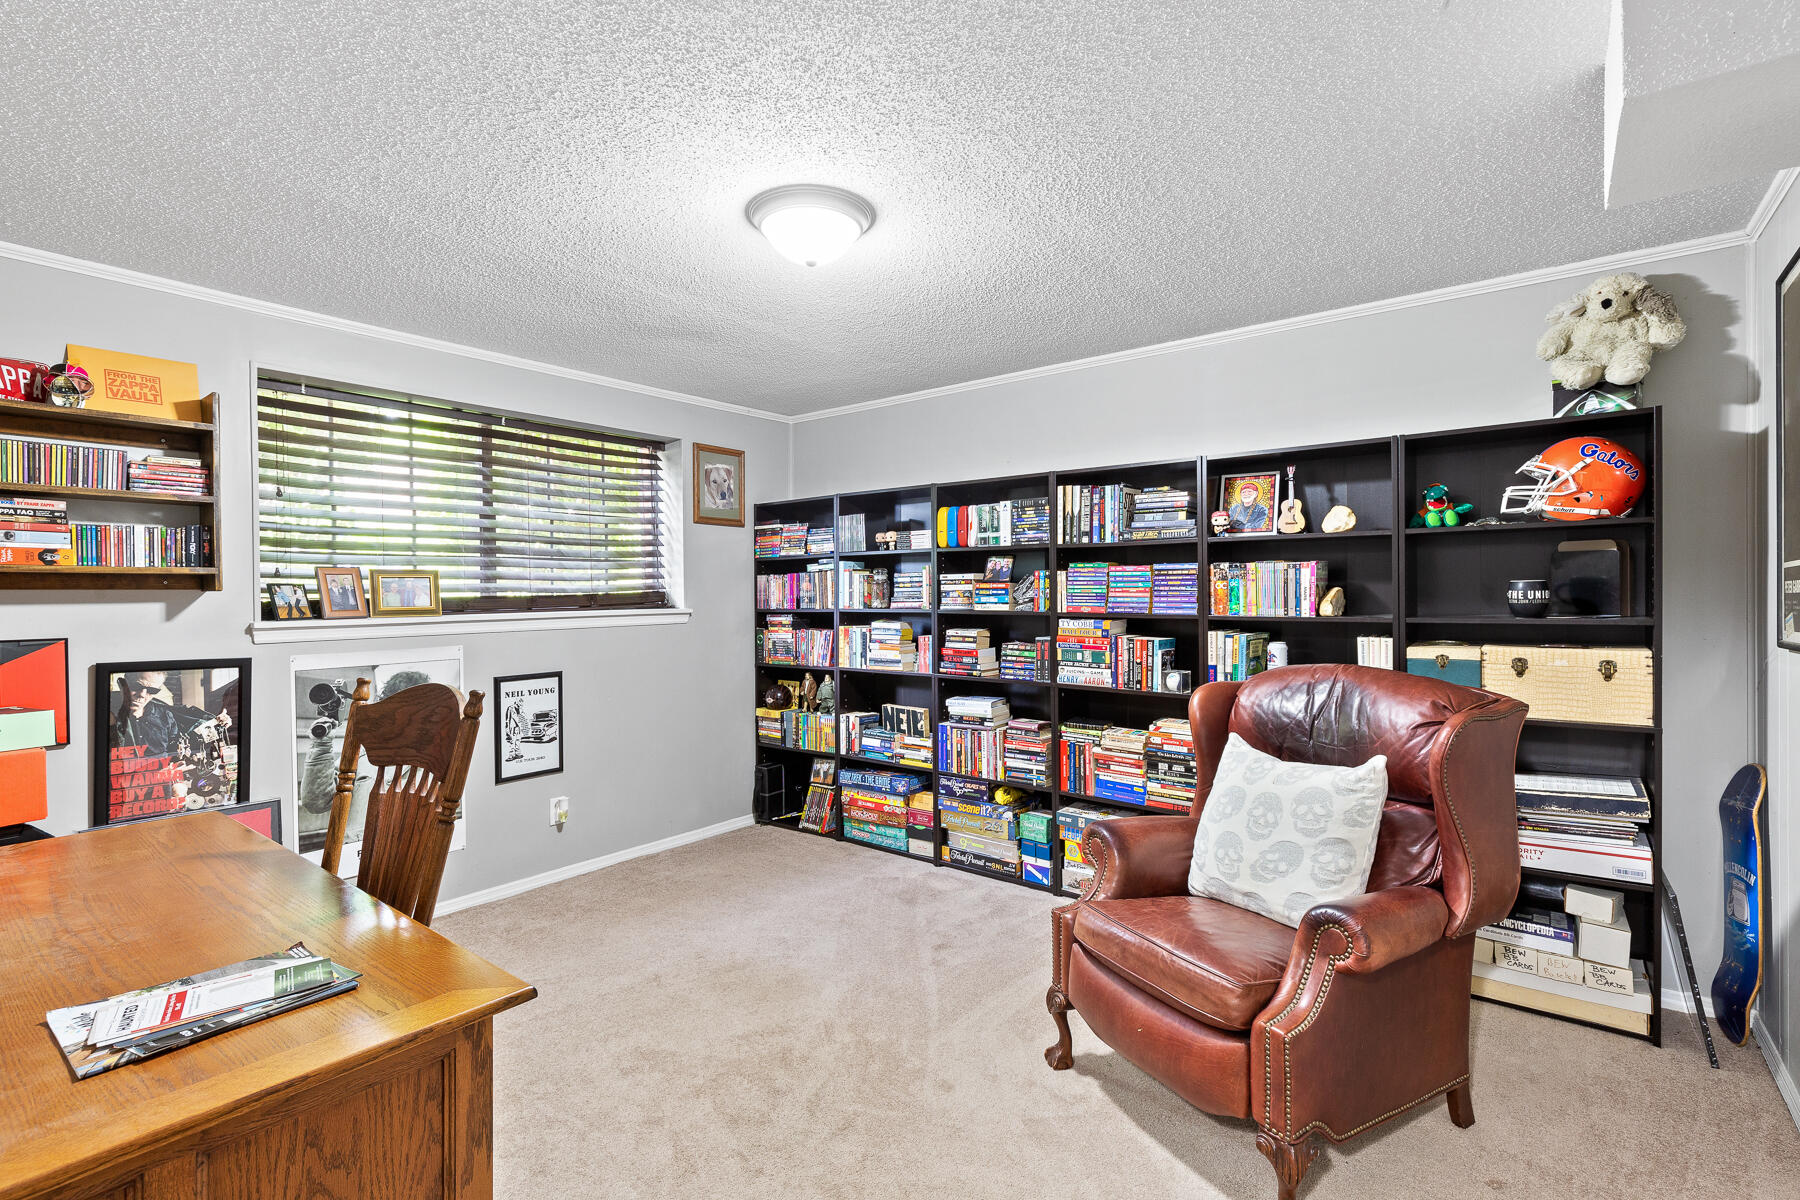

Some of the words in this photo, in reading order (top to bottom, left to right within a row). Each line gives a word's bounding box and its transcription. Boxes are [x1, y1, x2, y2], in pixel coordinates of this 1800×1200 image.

[0, 364, 43, 399] PPA
[107, 371, 137, 381] FROM
[140, 376, 158, 384] THE
[108, 378, 159, 393] ZAPPA
[108, 387, 159, 402] VAULT
[1579, 443, 1640, 481] Gators
[1508, 590, 1524, 599] THE
[1072, 620, 1093, 628] COBB
[1058, 674, 1079, 683] HENRY
[1083, 676, 1105, 686] AARON
[504, 690, 525, 699] NEIL
[528, 687, 556, 696] YOUNG
[111, 744, 148, 760] HEY
[111, 757, 172, 774] BUDDY
[111, 769, 184, 789] WANNA
[865, 774, 875, 785] THE
[110, 787, 148, 804] BUY
[152, 785, 164, 798] A
[957, 803, 980, 815] scene
[980, 804, 991, 817] it?
[1061, 827, 1082, 842] JEOP
[1519, 847, 1544, 856] RITY
[950, 849, 967, 861] Trivial
[965, 853, 985, 865] Pursuit
[991, 862, 1004, 870] SNL
[1502, 945, 1526, 957] BEW
[1507, 960, 1534, 971] CARDS
[1547, 957, 1568, 969] BEW
[1590, 964, 1616, 975] BEW
[1596, 979, 1627, 990] CARDS
